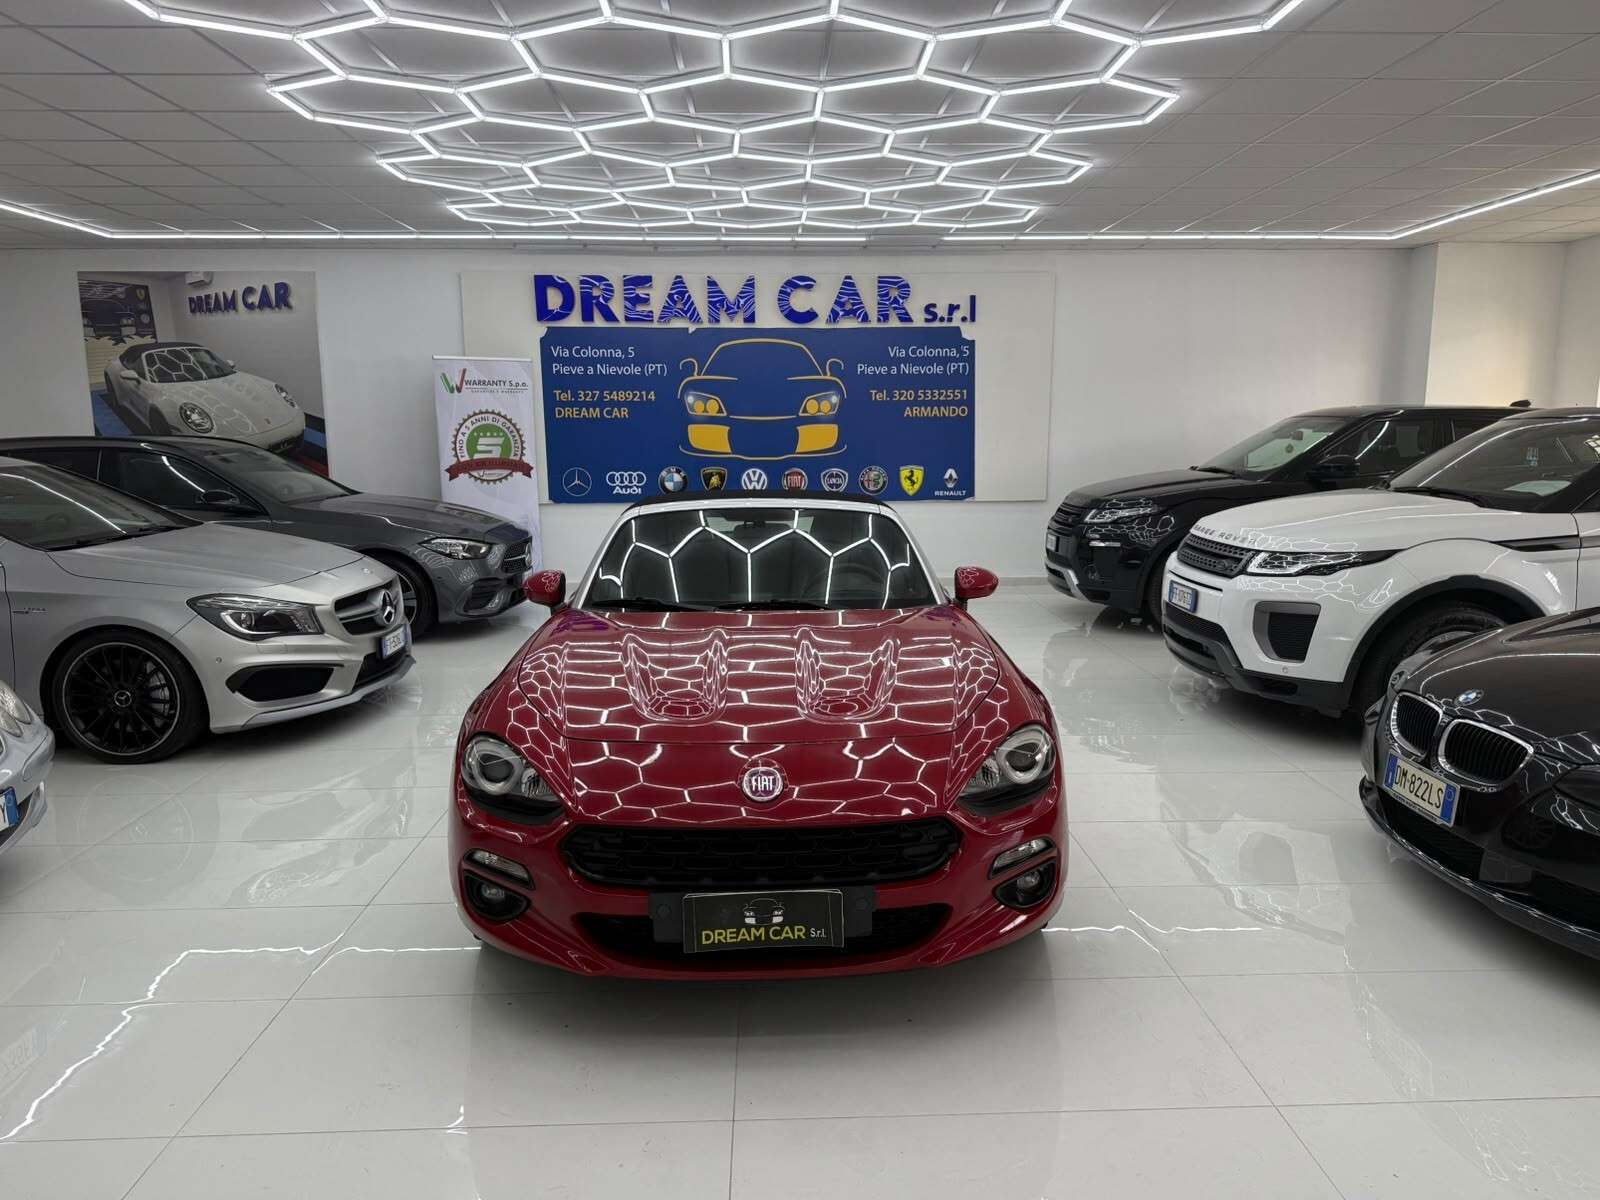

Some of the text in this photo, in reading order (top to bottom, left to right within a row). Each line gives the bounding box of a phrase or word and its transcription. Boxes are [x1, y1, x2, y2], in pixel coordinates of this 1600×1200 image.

[188, 281, 293, 314] DREAM CAR
[533, 274, 977, 324] DREAM CAR s.r.l
[551, 346, 635, 360] Via Colonna, 5
[888, 345, 907, 358] Via
[552, 361, 667, 376] Pieve a Nievole (PT)
[857, 361, 969, 376] Pieve a Nievole (PT)
[465, 379, 507, 387] WARRANTY
[554, 390, 656, 402] Tel. 327 5489214
[870, 389, 968, 402] Tel. 320 5332551
[554, 407, 629, 419] DREAM CAR
[903, 406, 969, 418] ARMANDO
[471, 415, 490, 426] ANNI
[612, 486, 642, 495] Audi
[751, 775, 775, 791] FIAT
[701, 927, 765, 945] DREAM
[769, 926, 806, 941] CAR
